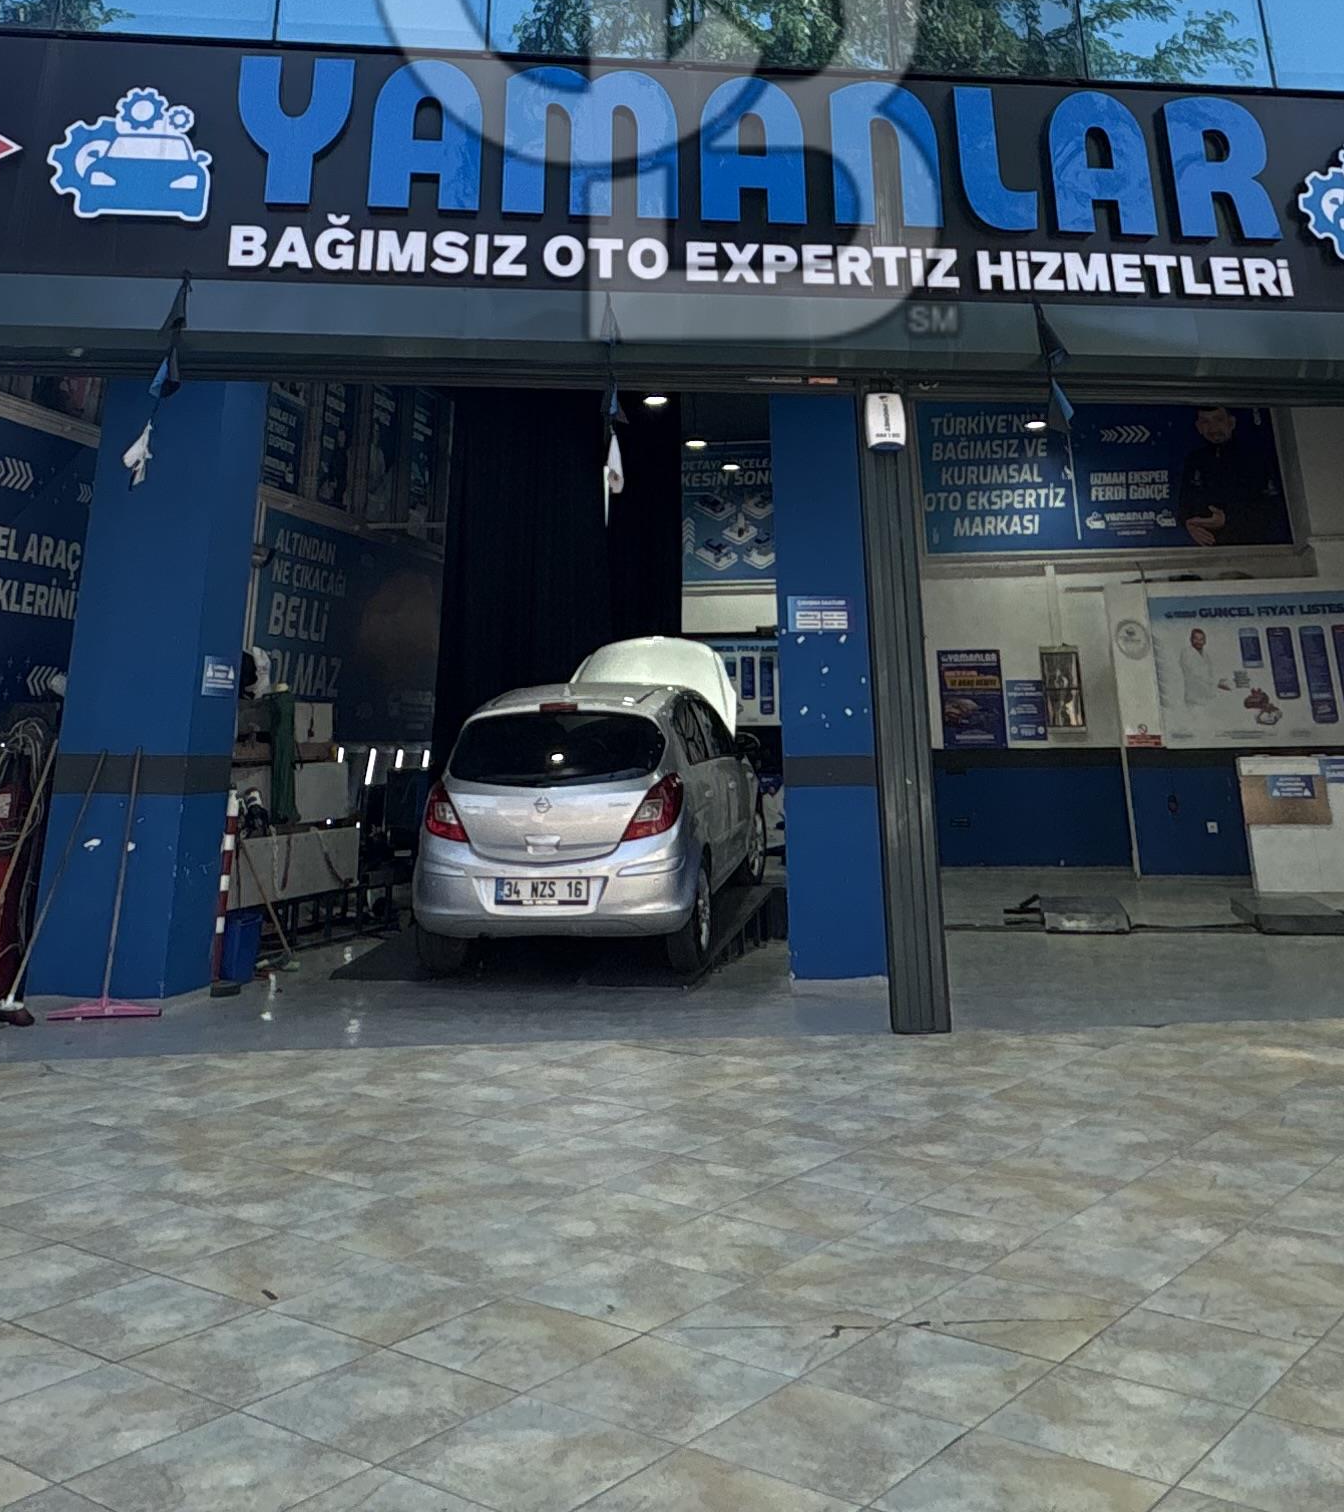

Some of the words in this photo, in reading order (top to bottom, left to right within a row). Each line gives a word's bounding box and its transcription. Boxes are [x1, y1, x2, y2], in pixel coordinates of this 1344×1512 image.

[237, 55, 1283, 242] YAMANLAR
[228, 214, 526, 278] BAĞIMSIZ
[542, 234, 671, 281] OTO
[931, 437, 1019, 462] BAĞIMSIZ
[1023, 438, 1048, 458] VE
[941, 464, 1043, 486] KURUMSAL
[924, 493, 962, 512] OTO
[953, 514, 1040, 538] MARKASI
[22, 532, 82, 580] ARAÇ
[504, 881, 521, 899] 34
[531, 881, 556, 899] NZS
[567, 881, 583, 898] 16
